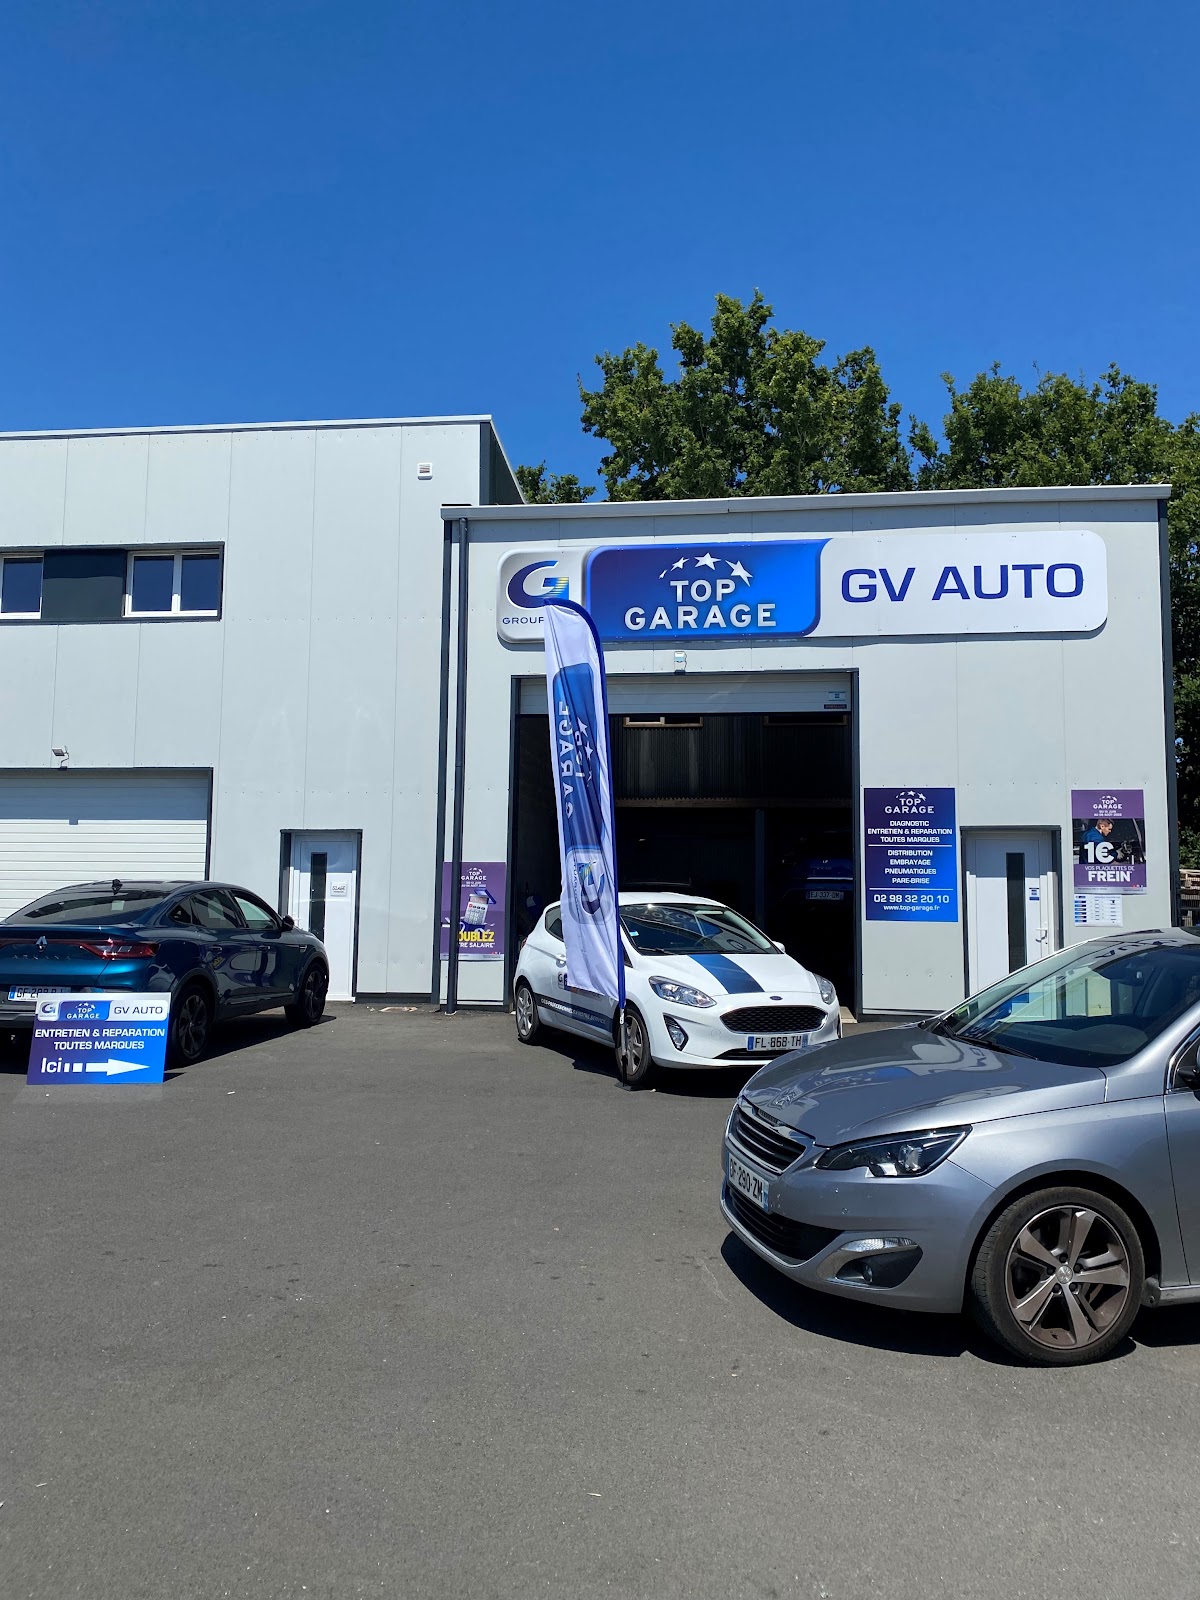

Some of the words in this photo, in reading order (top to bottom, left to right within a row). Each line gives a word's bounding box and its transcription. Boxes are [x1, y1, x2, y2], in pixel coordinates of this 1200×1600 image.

[841, 567, 916, 603] GV
[931, 563, 1084, 600] AUTO
[669, 578, 736, 603] TOP
[624, 603, 777, 631] GARAGE
[898, 798, 922, 806] TOP
[884, 806, 935, 814] GARAGE
[1083, 841, 1115, 864] 1€
[873, 894, 887, 903] 02
[889, 894, 902, 903] 98
[904, 894, 918, 903] 32
[920, 894, 934, 903] 20
[936, 894, 950, 904] 10
[883, 904, 940, 912] www.top-garage.fr
[113, 1006, 131, 1014] GV
[132, 1006, 163, 1015] AUTO
[34, 1028, 90, 1038] ENTRETIEN
[92, 1028, 100, 1037] &
[102, 1028, 165, 1037] REPARATION
[53, 1041, 92, 1050] TOUTES
[94, 1040, 145, 1050] MARQUES
[40, 1057, 63, 1073] Ici
